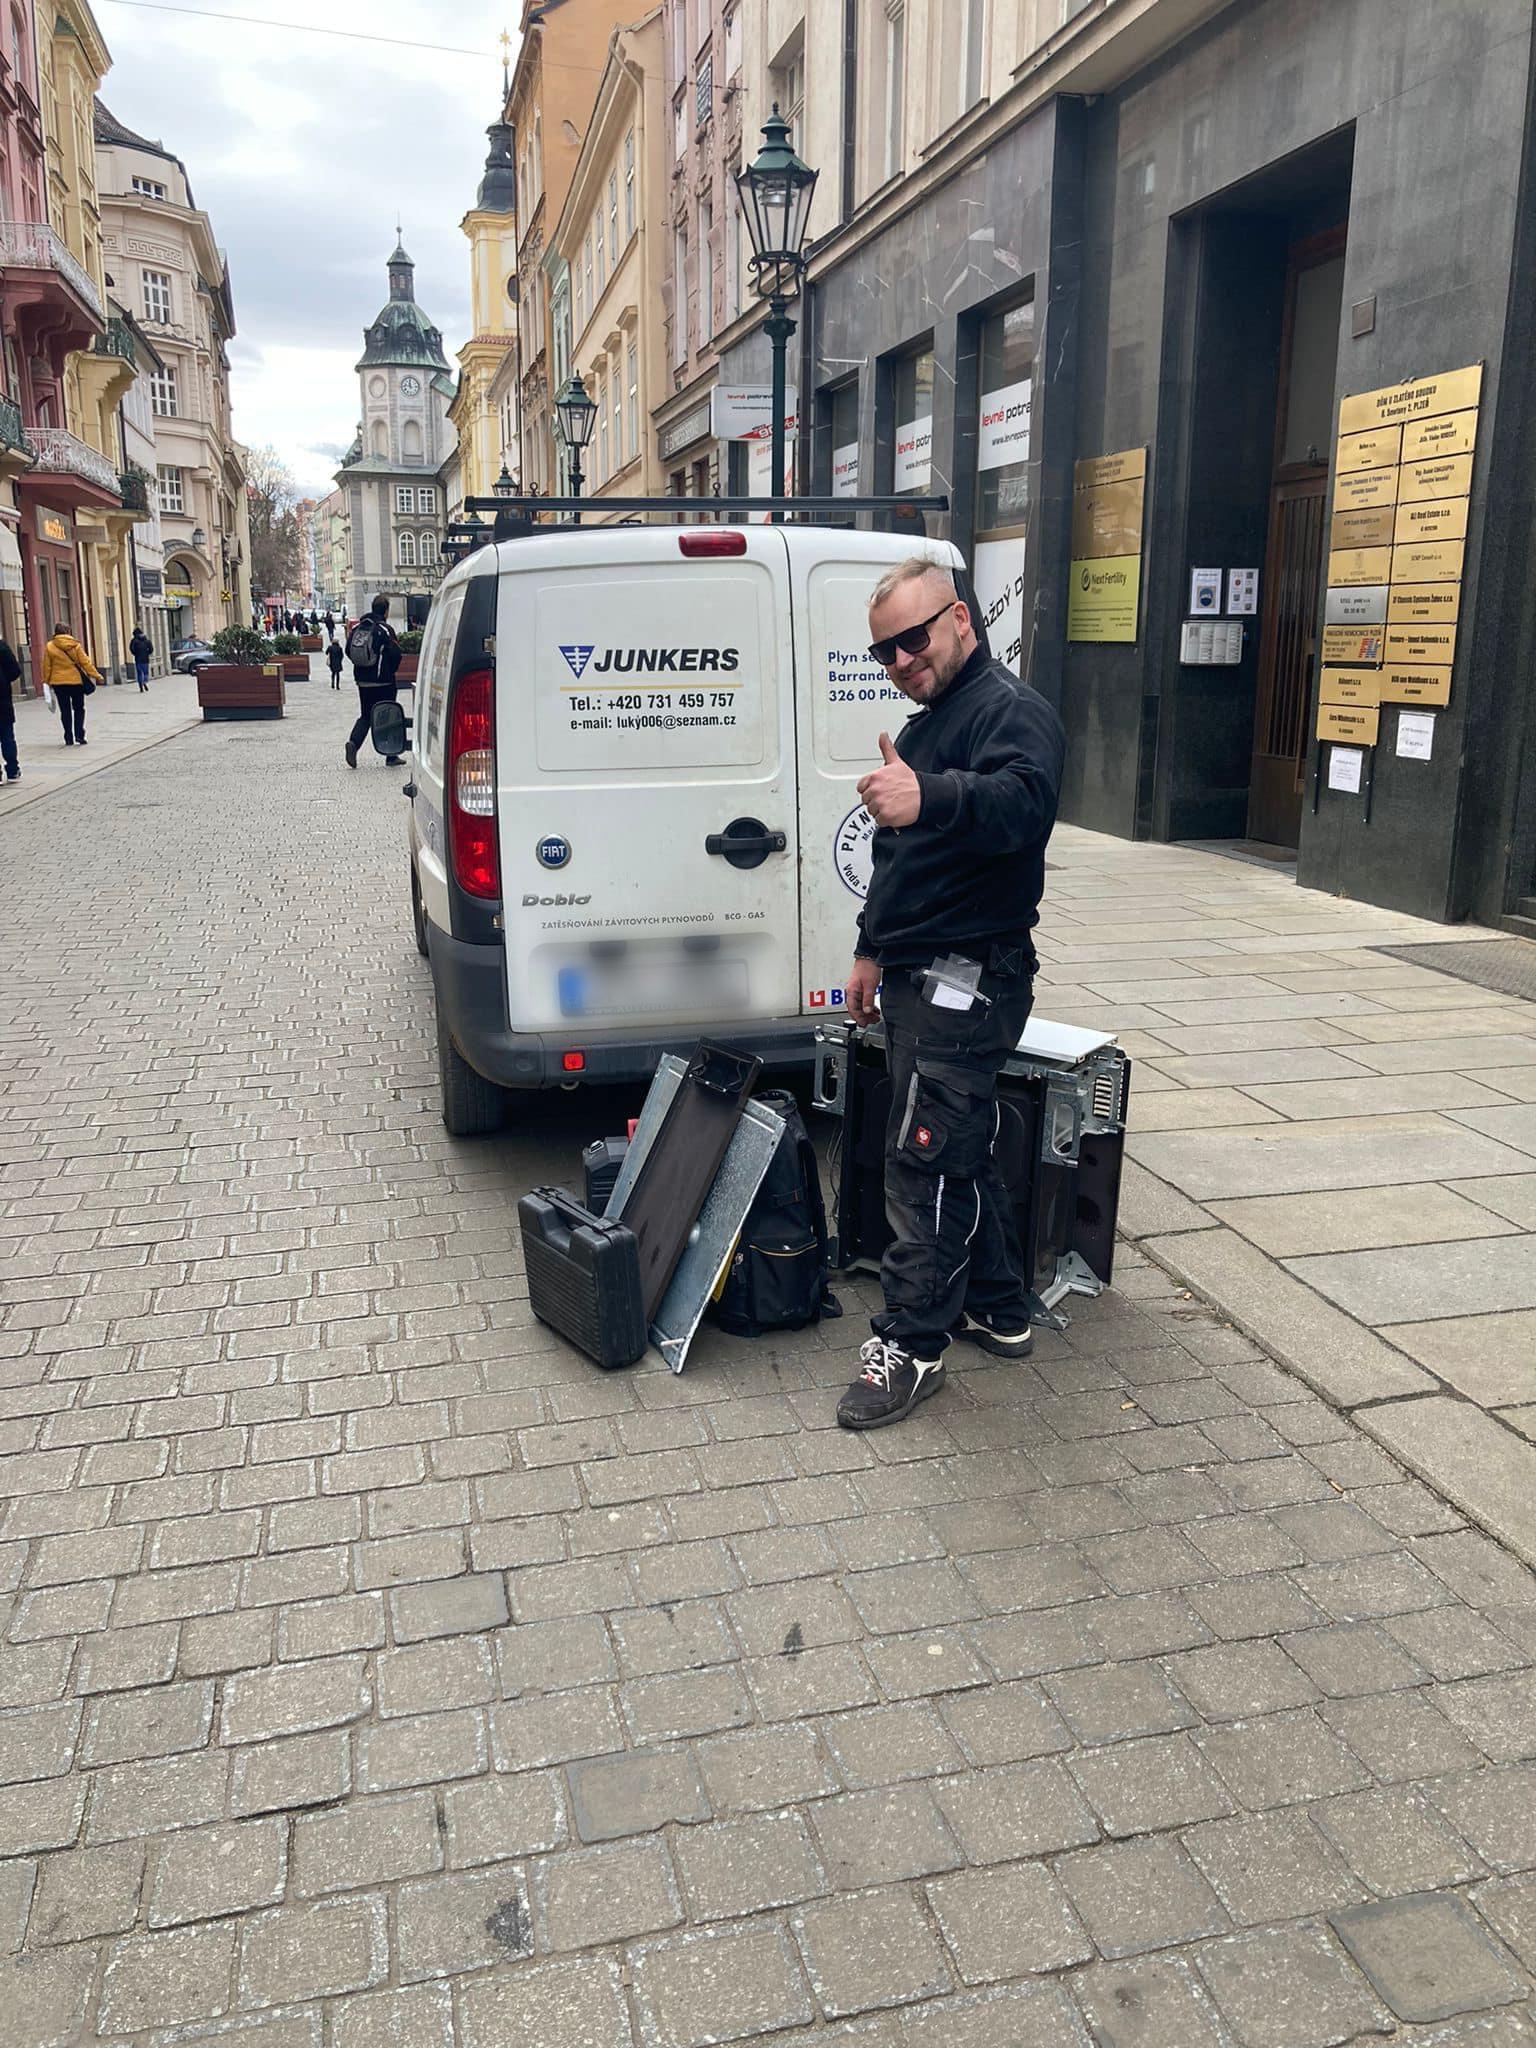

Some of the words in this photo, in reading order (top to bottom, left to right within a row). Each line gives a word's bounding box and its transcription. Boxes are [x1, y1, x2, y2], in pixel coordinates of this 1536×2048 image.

[982, 405, 1005, 428] levné
[897, 436, 915, 454] levné
[594, 648, 739, 672] JUNKERS
[828, 651, 858, 666] Plyn
[569, 696, 602, 711] Tel.:
[607, 695, 642, 710] +420
[647, 694, 671, 709] 731
[679, 693, 704, 708] 459
[710, 692, 735, 707] 757
[829, 689, 855, 702] 326
[858, 689, 876, 701] 00
[880, 688, 909, 700] Plze
[571, 716, 612, 730] e-mail:
[541, 845, 566, 858] FIAT
[842, 863, 860, 887] Voda
[604, 915, 660, 927] ZÁVITOVÝCH
[661, 912, 715, 924] PLYNOVODŮ
[725, 912, 741, 921] BCG
[748, 911, 766, 920] GAS
